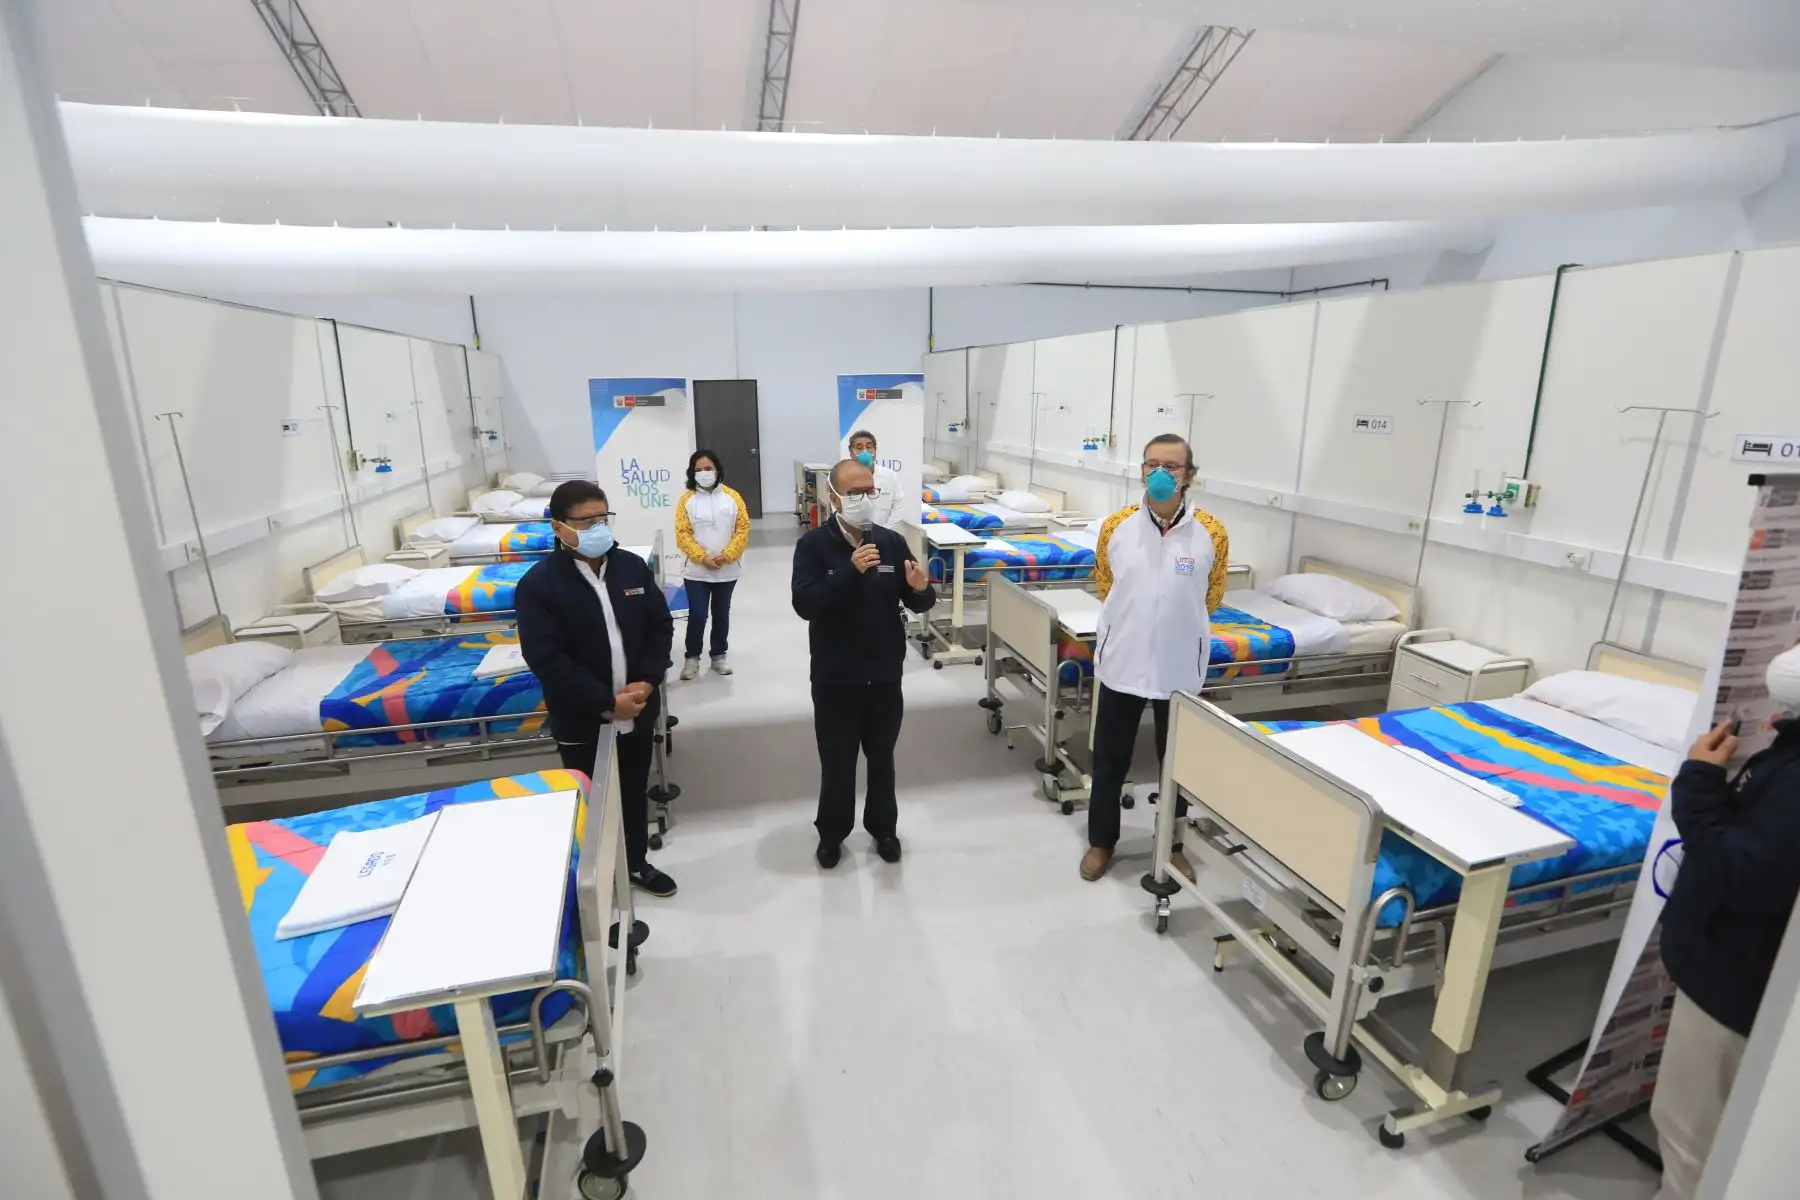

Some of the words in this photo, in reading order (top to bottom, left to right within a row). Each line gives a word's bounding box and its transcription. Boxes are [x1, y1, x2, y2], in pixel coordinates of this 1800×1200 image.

[1371, 419, 1387, 430] 014
[620, 457, 640, 472] LA
[621, 468, 671, 485] SALUD
[626, 482, 659, 497] NOS
[640, 493, 671, 509] UNE
[1175, 563, 1195, 572] 2019
